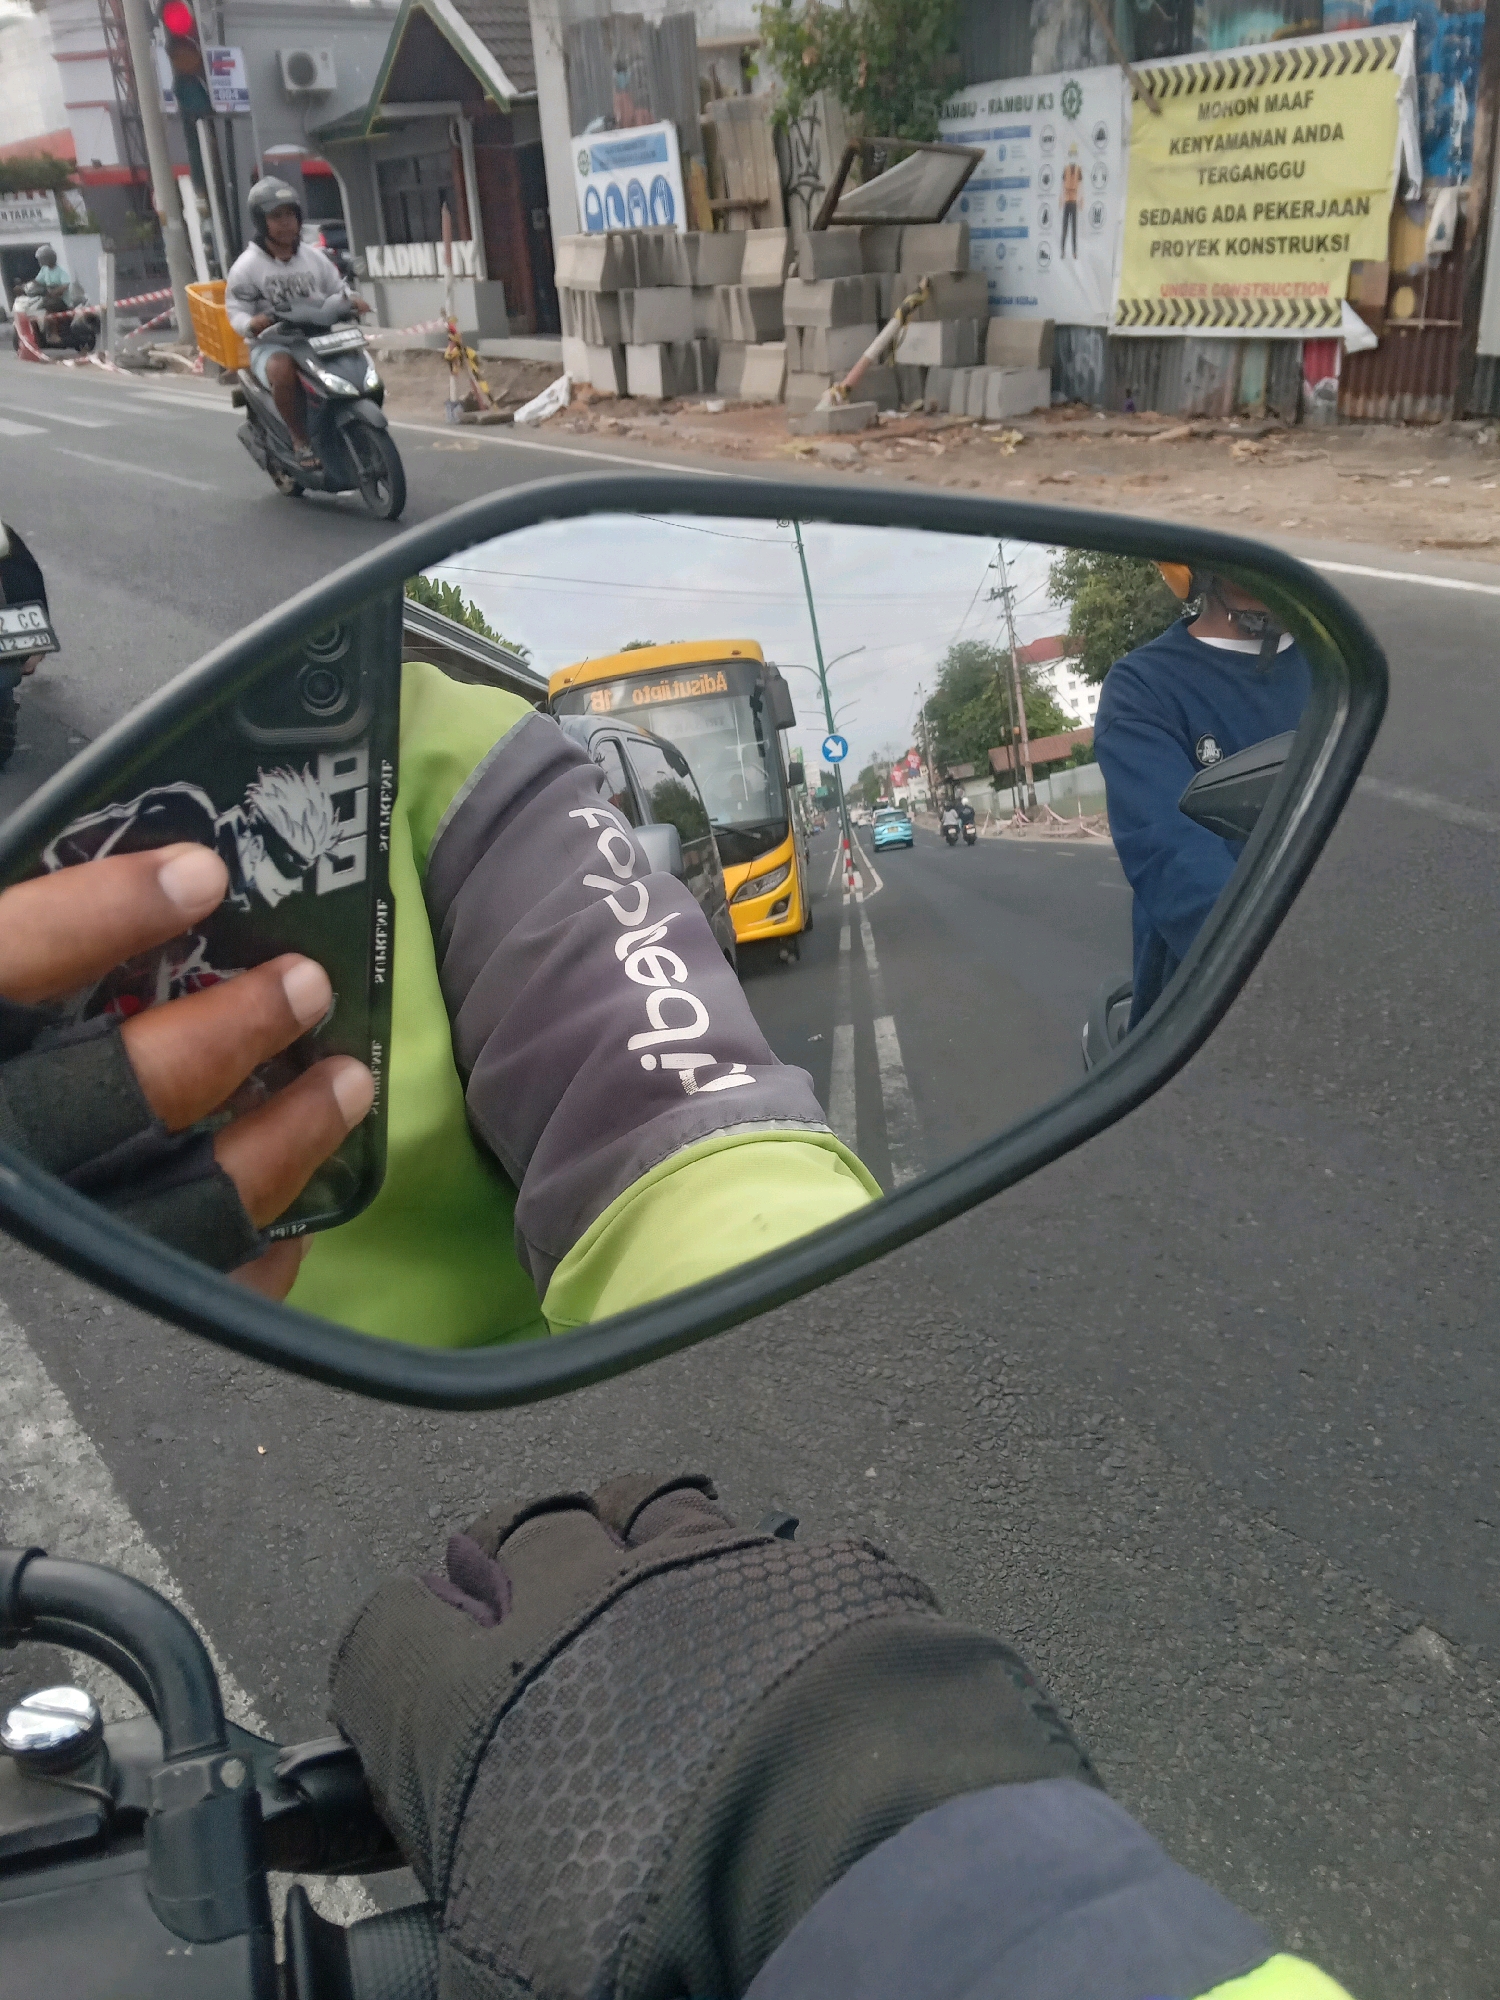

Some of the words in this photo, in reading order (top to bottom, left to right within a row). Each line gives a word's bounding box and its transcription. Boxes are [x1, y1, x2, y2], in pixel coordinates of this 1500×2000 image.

[940, 101, 978, 120] AMBU
[988, 94, 1035, 115] RAMBU
[1198, 96, 1259, 121] MOHON
[1264, 89, 1314, 113] MAAF
[1169, 126, 1287, 155] KENYAMANAN
[1292, 122, 1344, 144] ANDA
[1198, 160, 1306, 185] TERGANGGU
[1138, 205, 1206, 226] SEDANG
[1212, 203, 1247, 223] ADA
[1253, 196, 1370, 221] PEKERJAAN
[1150, 238, 1219, 258] PROYEK
[1225, 232, 1350, 256] KONSTRUKSI
